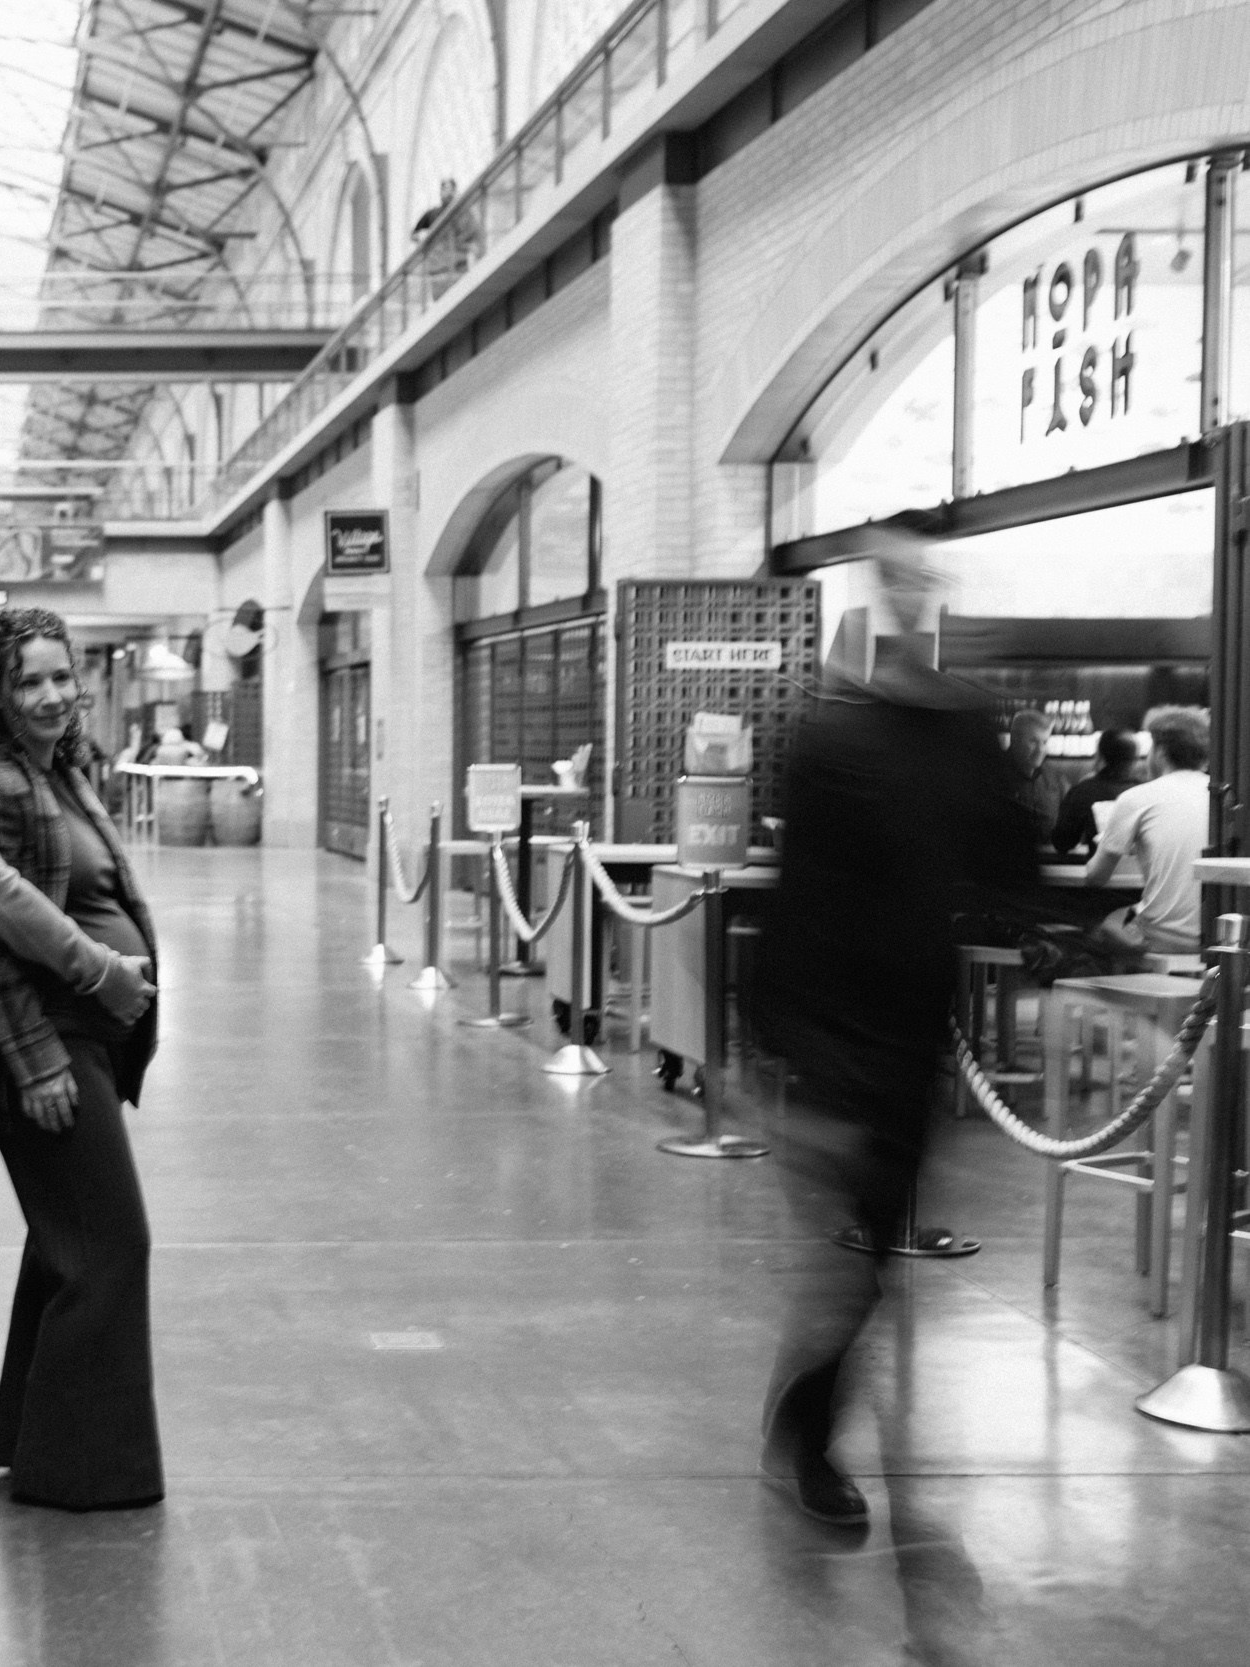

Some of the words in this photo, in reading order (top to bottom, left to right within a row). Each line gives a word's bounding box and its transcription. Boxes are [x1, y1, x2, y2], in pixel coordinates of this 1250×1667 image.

[1020, 329, 1134, 444] FISH
[673, 648, 722, 662] START
[730, 648, 773, 661] HERE
[686, 823, 741, 846] EXIT
